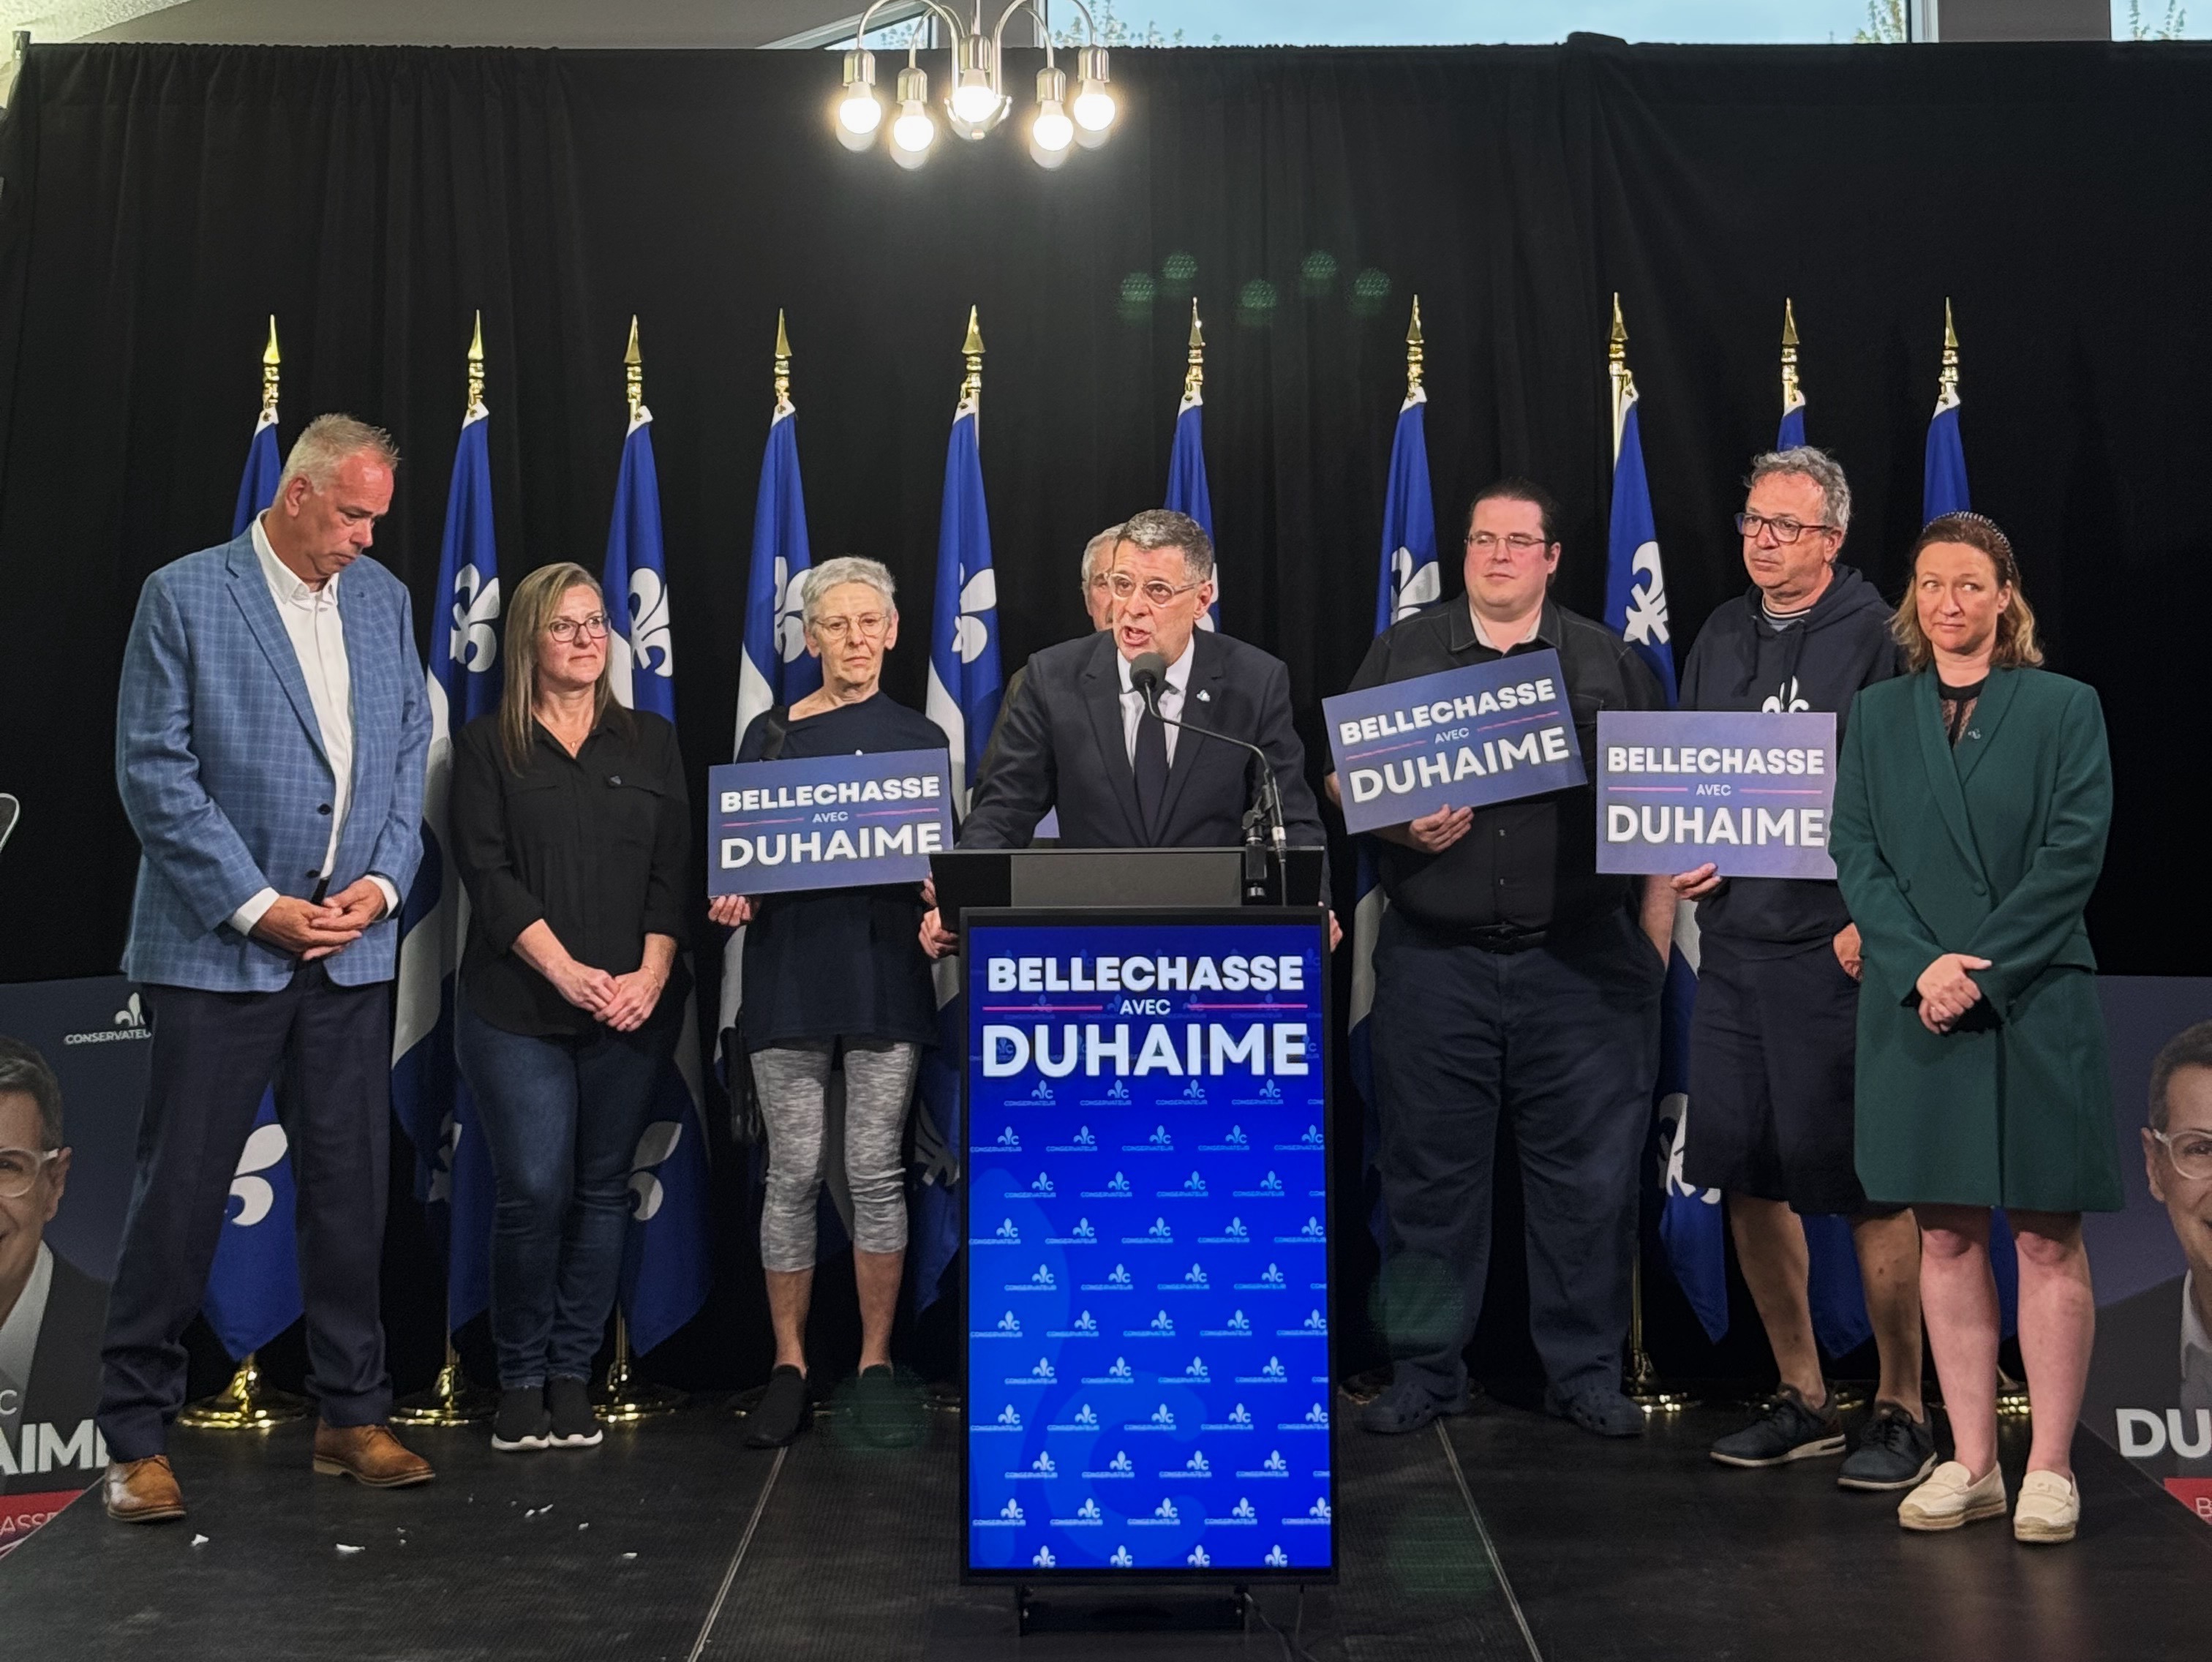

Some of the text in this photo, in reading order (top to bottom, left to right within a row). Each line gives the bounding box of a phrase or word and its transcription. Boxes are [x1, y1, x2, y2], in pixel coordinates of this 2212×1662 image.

[1339, 678, 1556, 745] BELLECHASSE
[1434, 727, 1470, 745] AVEC
[1349, 726, 1570, 803] DUHAIME
[1607, 747, 1825, 775] BELLECHASSE
[720, 775, 941, 813] BELLECHASSE
[1696, 783, 1732, 797] AVEC
[812, 811, 849, 823] AVEC
[1607, 805, 1825, 846] DUHAIME
[721, 822, 942, 870] DUHAIME
[988, 955, 1304, 992] BELLECHASSE
[1119, 999, 1171, 1015] AVEC
[64, 1029, 151, 1045] CONSERVATEU
[982, 1023, 1309, 1078] DUHAIME
